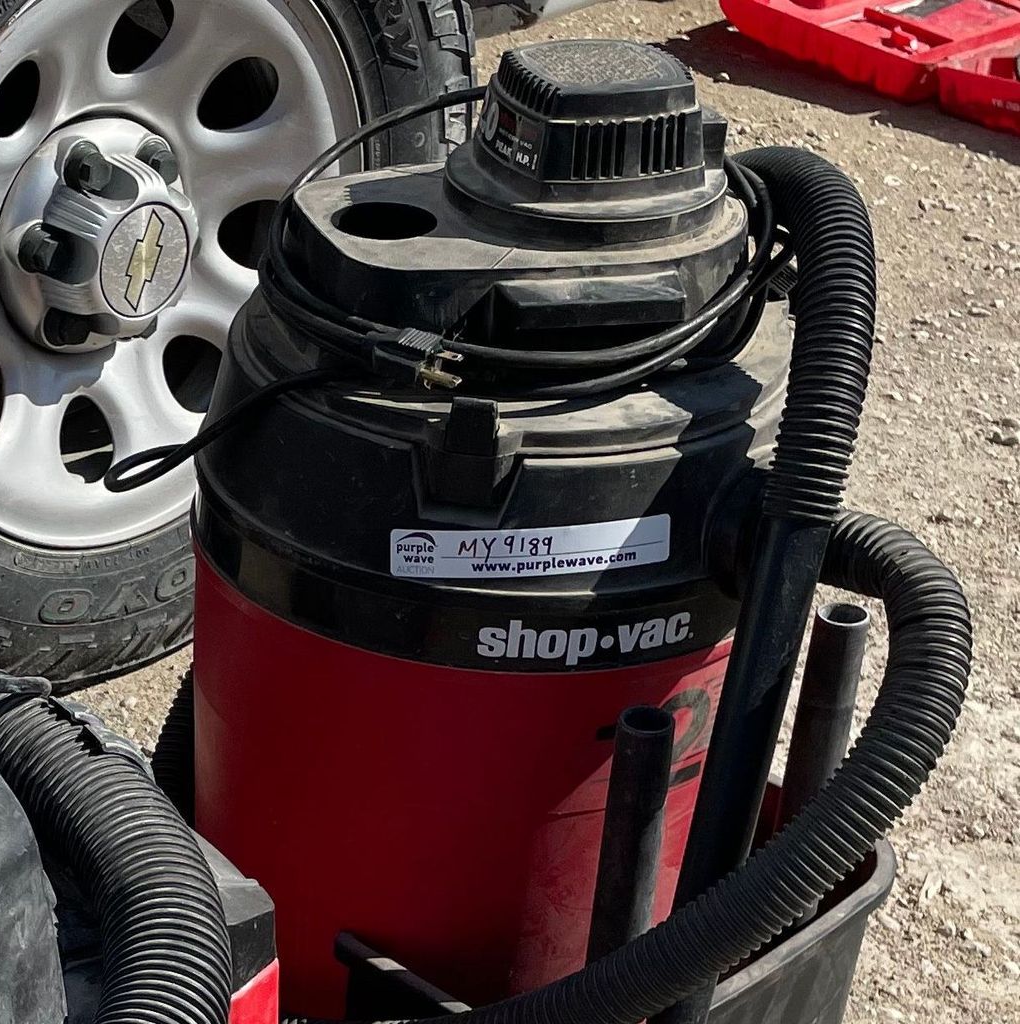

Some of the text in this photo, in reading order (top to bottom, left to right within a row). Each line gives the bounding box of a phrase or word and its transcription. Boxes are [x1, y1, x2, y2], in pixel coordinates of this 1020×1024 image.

[396, 542, 435, 554] purple
[403, 554, 435, 563] wave
[471, 550, 637, 573] www.purplewave.com
[396, 565, 435, 574] AUCTION
[38, 557, 196, 624] OYO
